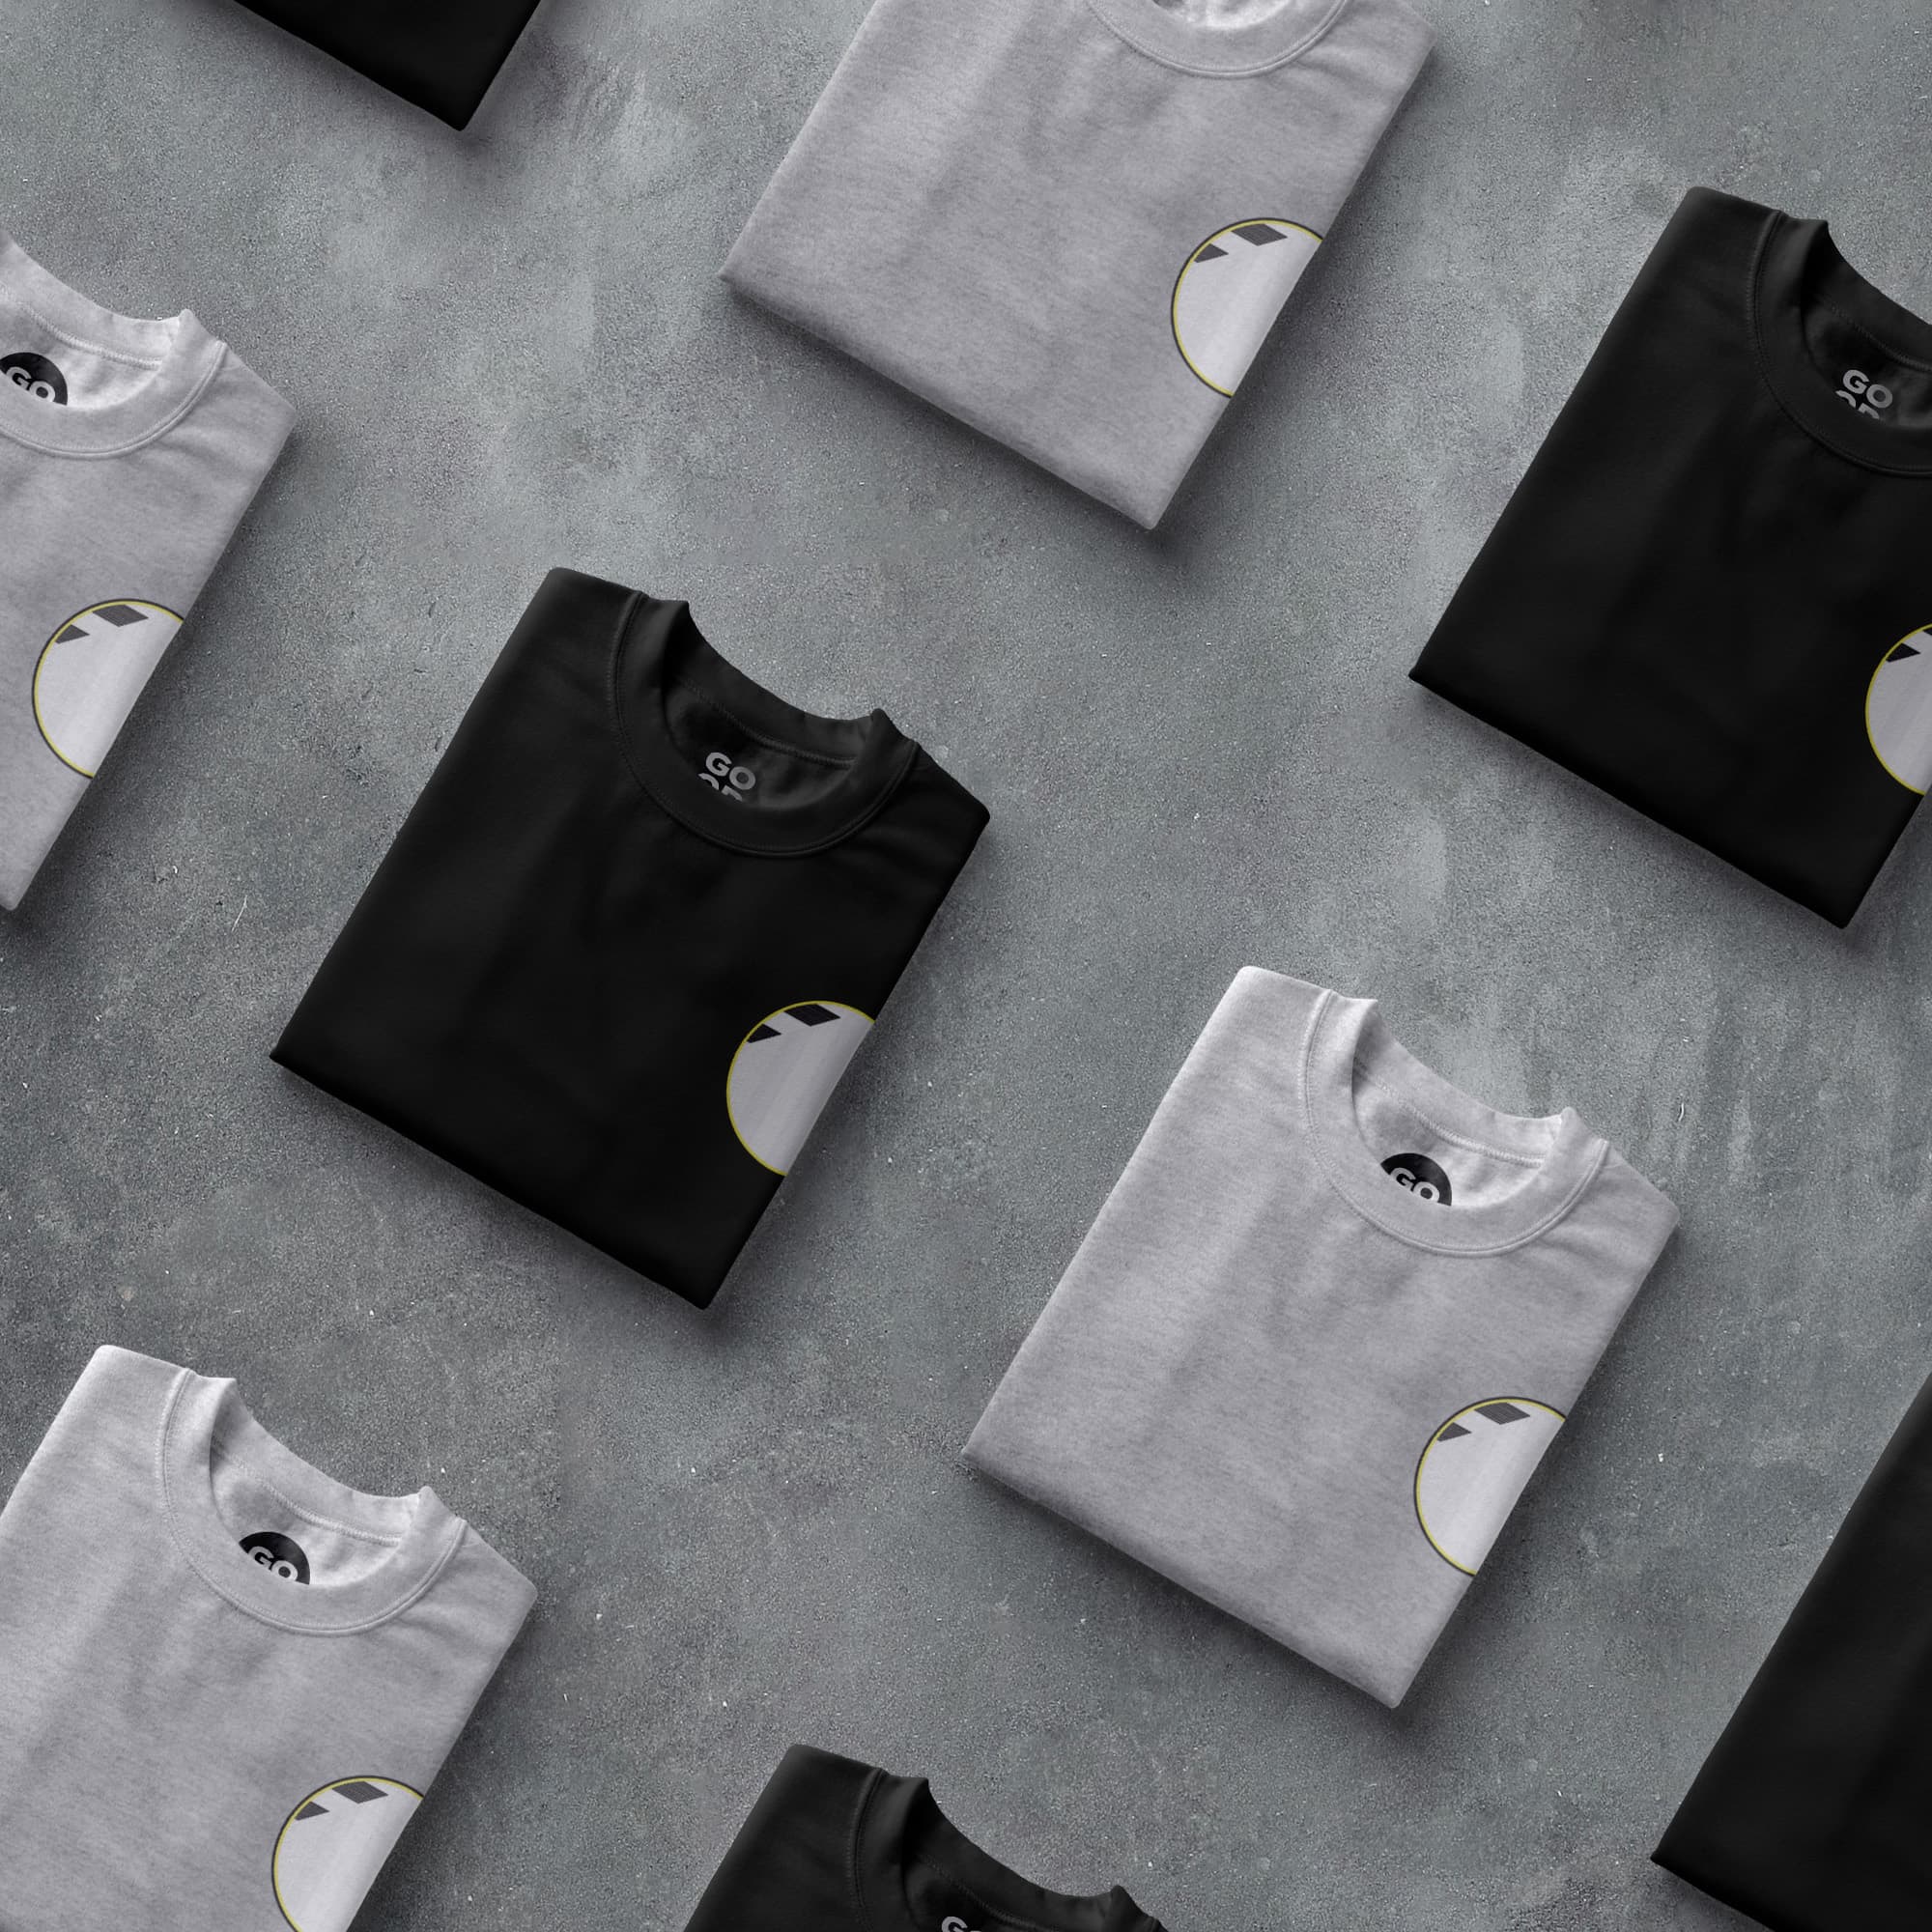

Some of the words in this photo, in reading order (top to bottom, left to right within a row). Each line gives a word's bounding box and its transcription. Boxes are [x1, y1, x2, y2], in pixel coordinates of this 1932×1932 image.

[6, 366, 56, 403] GO
[1842, 369, 1893, 409] GO
[705, 752, 755, 790] GO
[1390, 1167, 1439, 1204] GO
[248, 1546, 298, 1581] GO
